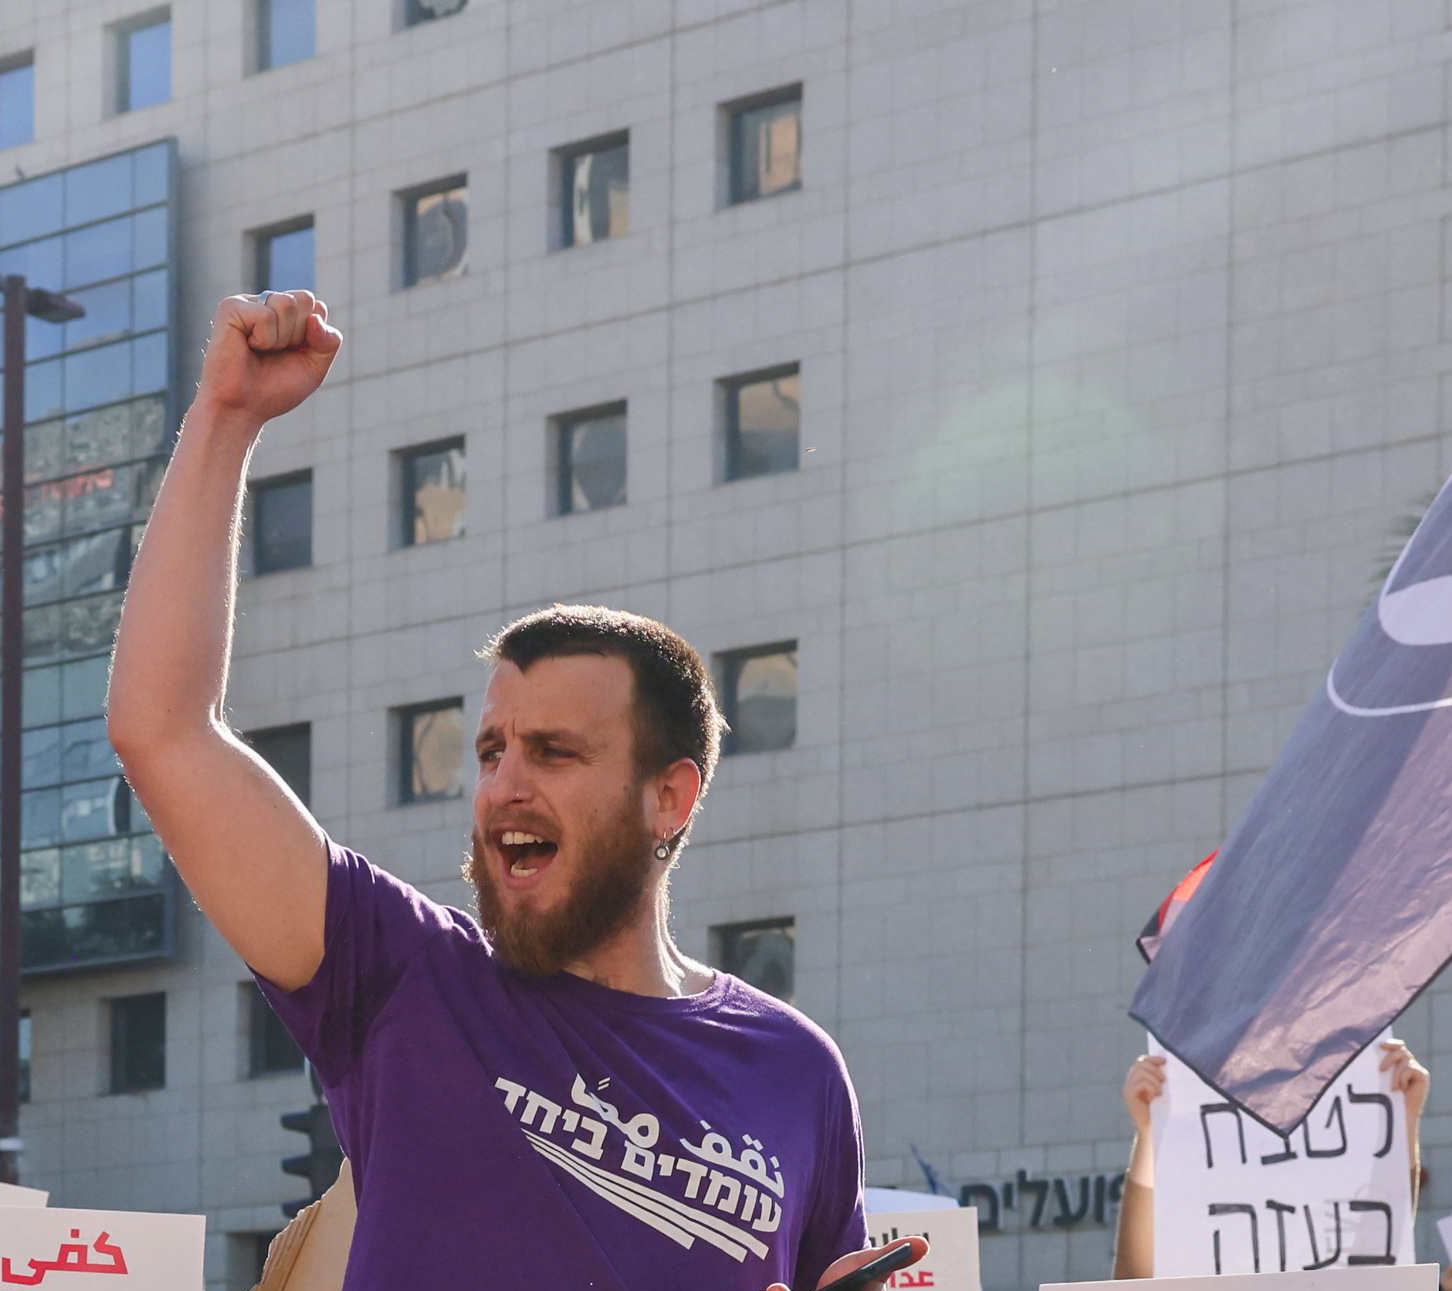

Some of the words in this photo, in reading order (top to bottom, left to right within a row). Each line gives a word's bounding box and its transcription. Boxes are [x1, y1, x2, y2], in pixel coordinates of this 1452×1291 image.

[494, 1077, 608, 1160] ביחד
[620, 1140, 783, 1233] עומדים
[1, 1222, 129, 1286] كفى
